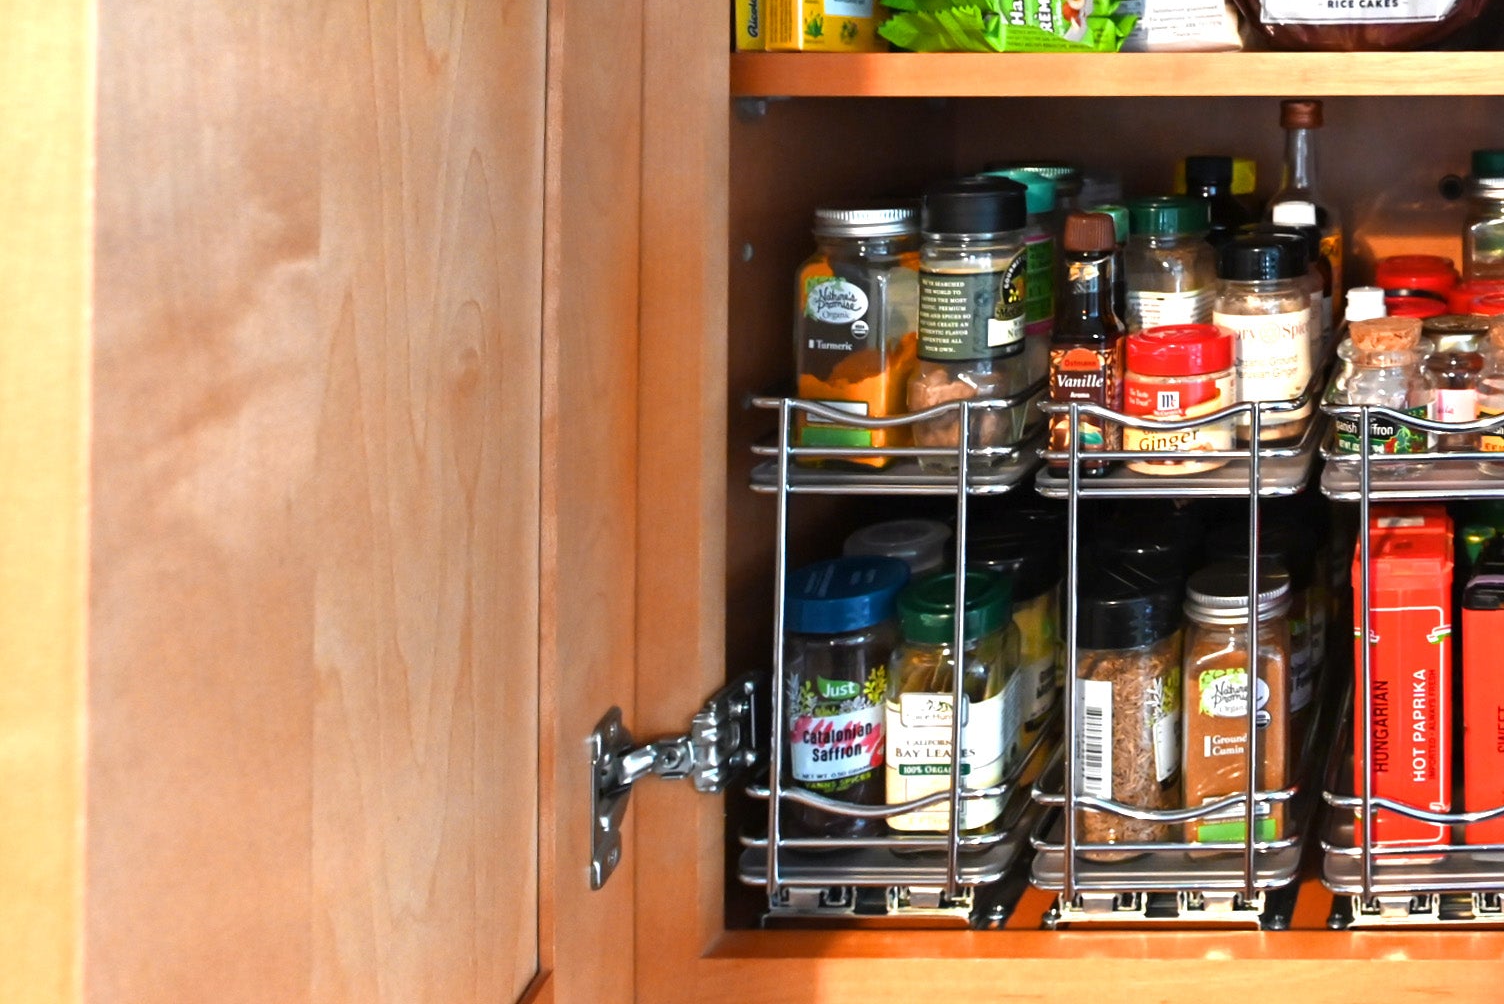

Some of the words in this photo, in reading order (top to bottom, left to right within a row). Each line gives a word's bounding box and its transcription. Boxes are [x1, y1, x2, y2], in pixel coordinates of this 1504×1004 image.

[1327, 0, 1354, 9] RICE
[819, 286, 857, 302] Nature's
[815, 299, 862, 313] Promise
[816, 339, 853, 351] Turmeric
[1057, 374, 1104, 388] Vanille
[1369, 423, 1394, 435] ffron
[1139, 429, 1200, 451] Ginger
[823, 681, 856, 698] Just
[1412, 669, 1426, 742] PAPRIKA
[802, 723, 873, 744] Catalonian
[1373, 680, 1389, 773] HUNGARIAN
[1212, 733, 1247, 744] Ground
[812, 743, 862, 762] Saffron
[895, 748, 920, 757] BAY
[926, 748, 976, 757] LEAES
[1212, 745, 1244, 756] Cumin
[903, 764, 923, 774] 100%
[1412, 747, 1426, 782] HOT
